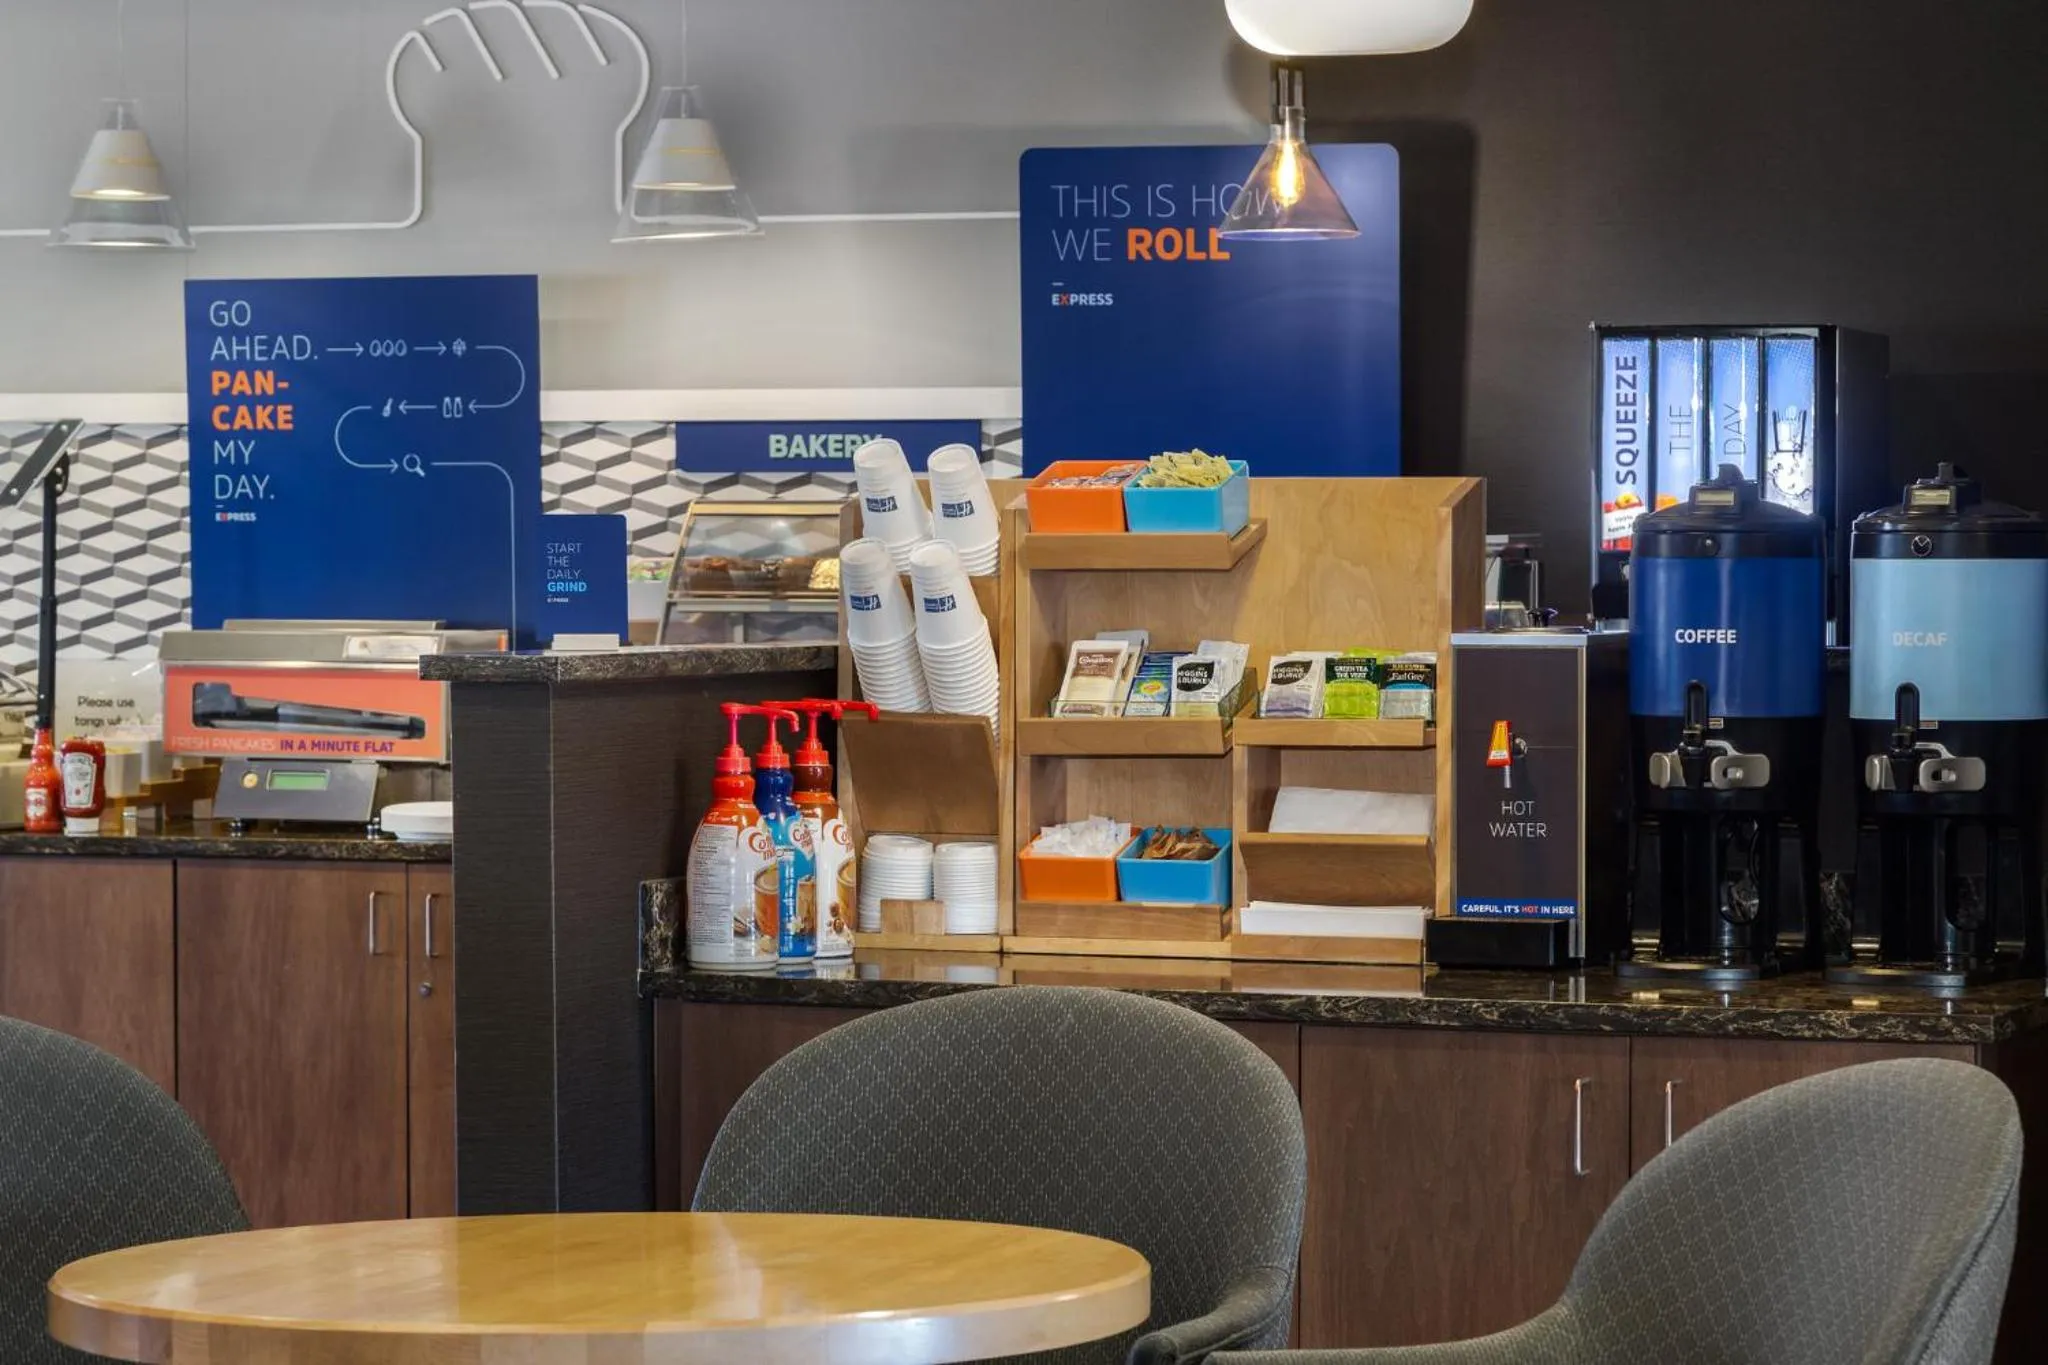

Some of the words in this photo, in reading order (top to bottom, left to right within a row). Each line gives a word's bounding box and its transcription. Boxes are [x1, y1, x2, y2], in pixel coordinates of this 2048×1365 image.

[1051, 184, 1131, 218] THIS
[1147, 184, 1177, 217] IS
[1052, 228, 1112, 261] WE
[1127, 228, 1231, 261] ROLL
[1051, 293, 1114, 306] EXPRESS
[210, 300, 251, 327] GO
[210, 335, 318, 361] AHEAD.
[212, 370, 289, 396] PAN-
[212, 405, 294, 431] CAKE
[1615, 355, 1639, 485] SQUEEZE
[1669, 404, 1692, 455] THE
[1723, 403, 1747, 456] DAY
[214, 440, 255, 465] MY
[768, 434, 883, 459] BAKER
[215, 474, 275, 500] DAY.
[546, 543, 582, 554] START
[547, 556, 569, 567] THE
[546, 569, 581, 580] DAILY
[547, 582, 587, 592] GRIND
[1675, 629, 1737, 644] COFFEE
[1892, 632, 1948, 647] DECAF
[77, 695, 113, 708] Please
[117, 699, 135, 708] use
[280, 739, 294, 751] IN
[298, 739, 306, 751] A
[311, 740, 360, 752] MINUTE
[364, 741, 395, 753] FLAT
[1501, 800, 1534, 815] HOT
[1489, 822, 1547, 837] WATER
[1521, 906, 1539, 914] HOT
[1540, 906, 1551, 914] IN
[1552, 906, 1575, 914] HERE
